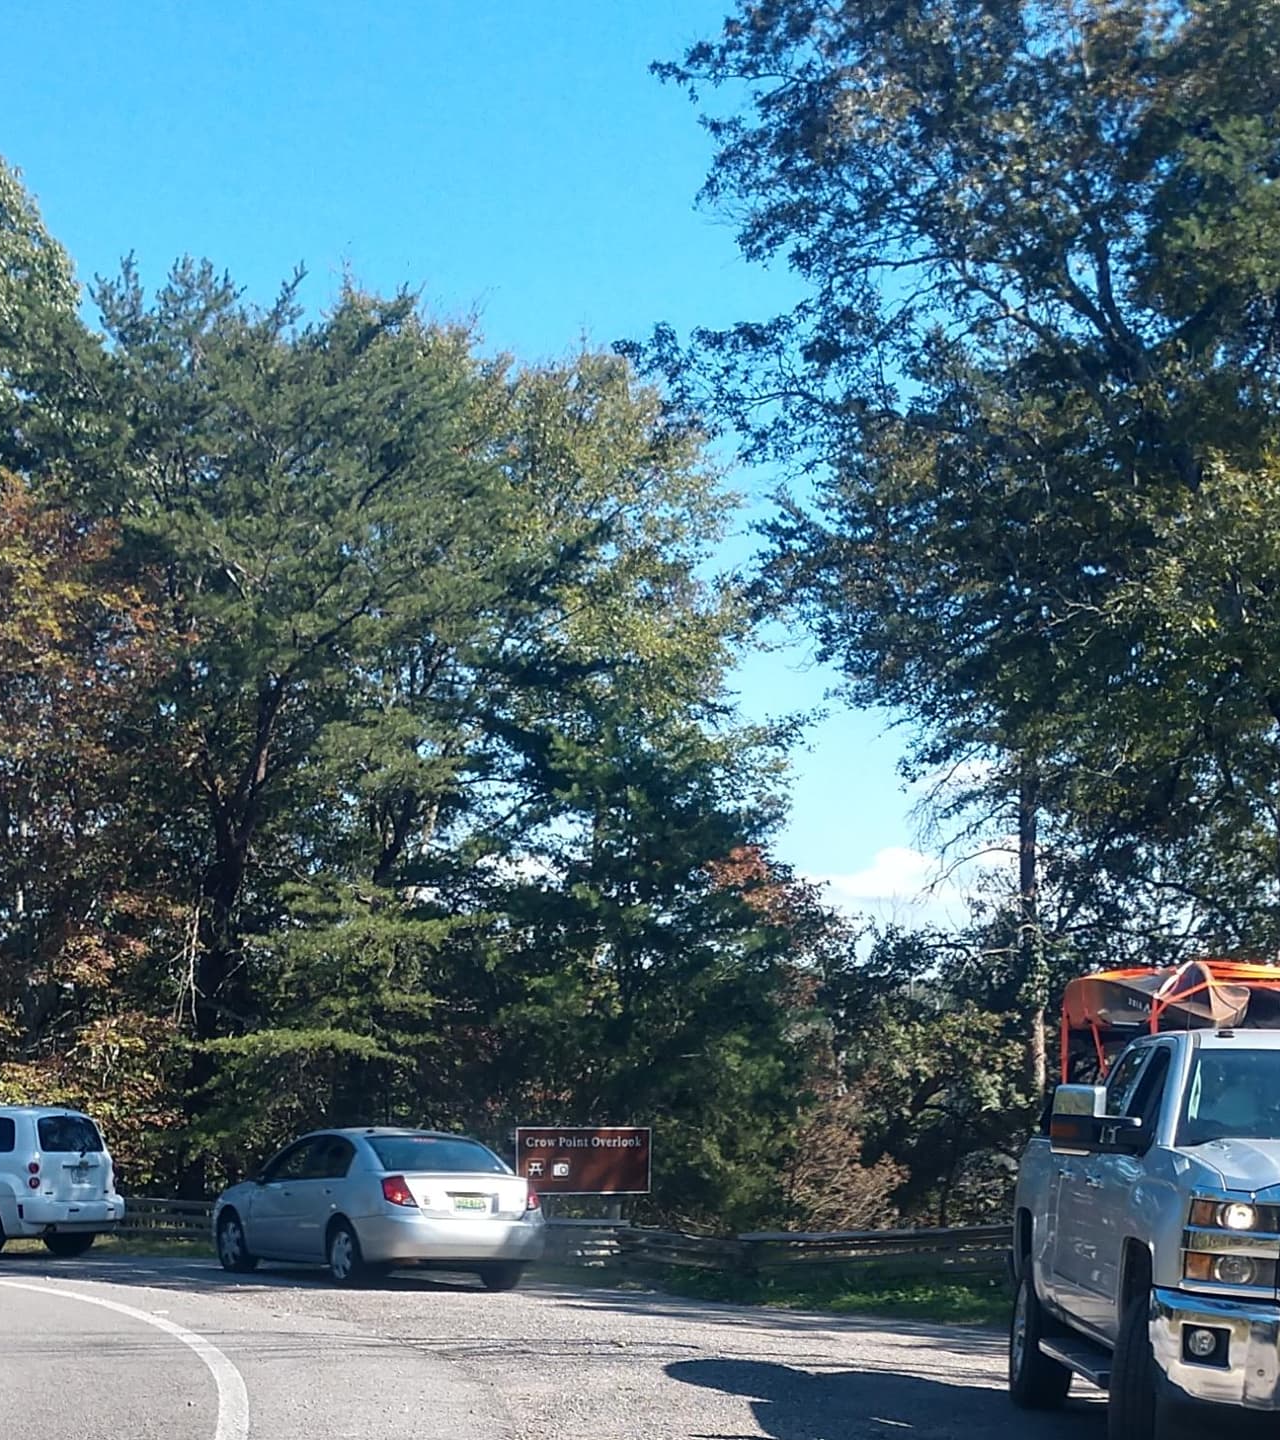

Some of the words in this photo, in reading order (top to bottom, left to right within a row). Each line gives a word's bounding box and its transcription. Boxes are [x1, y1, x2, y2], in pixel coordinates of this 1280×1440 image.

[525, 1136, 556, 1148] Crow
[559, 1136, 588, 1148] Point
[591, 1135, 641, 1148] Overlook
